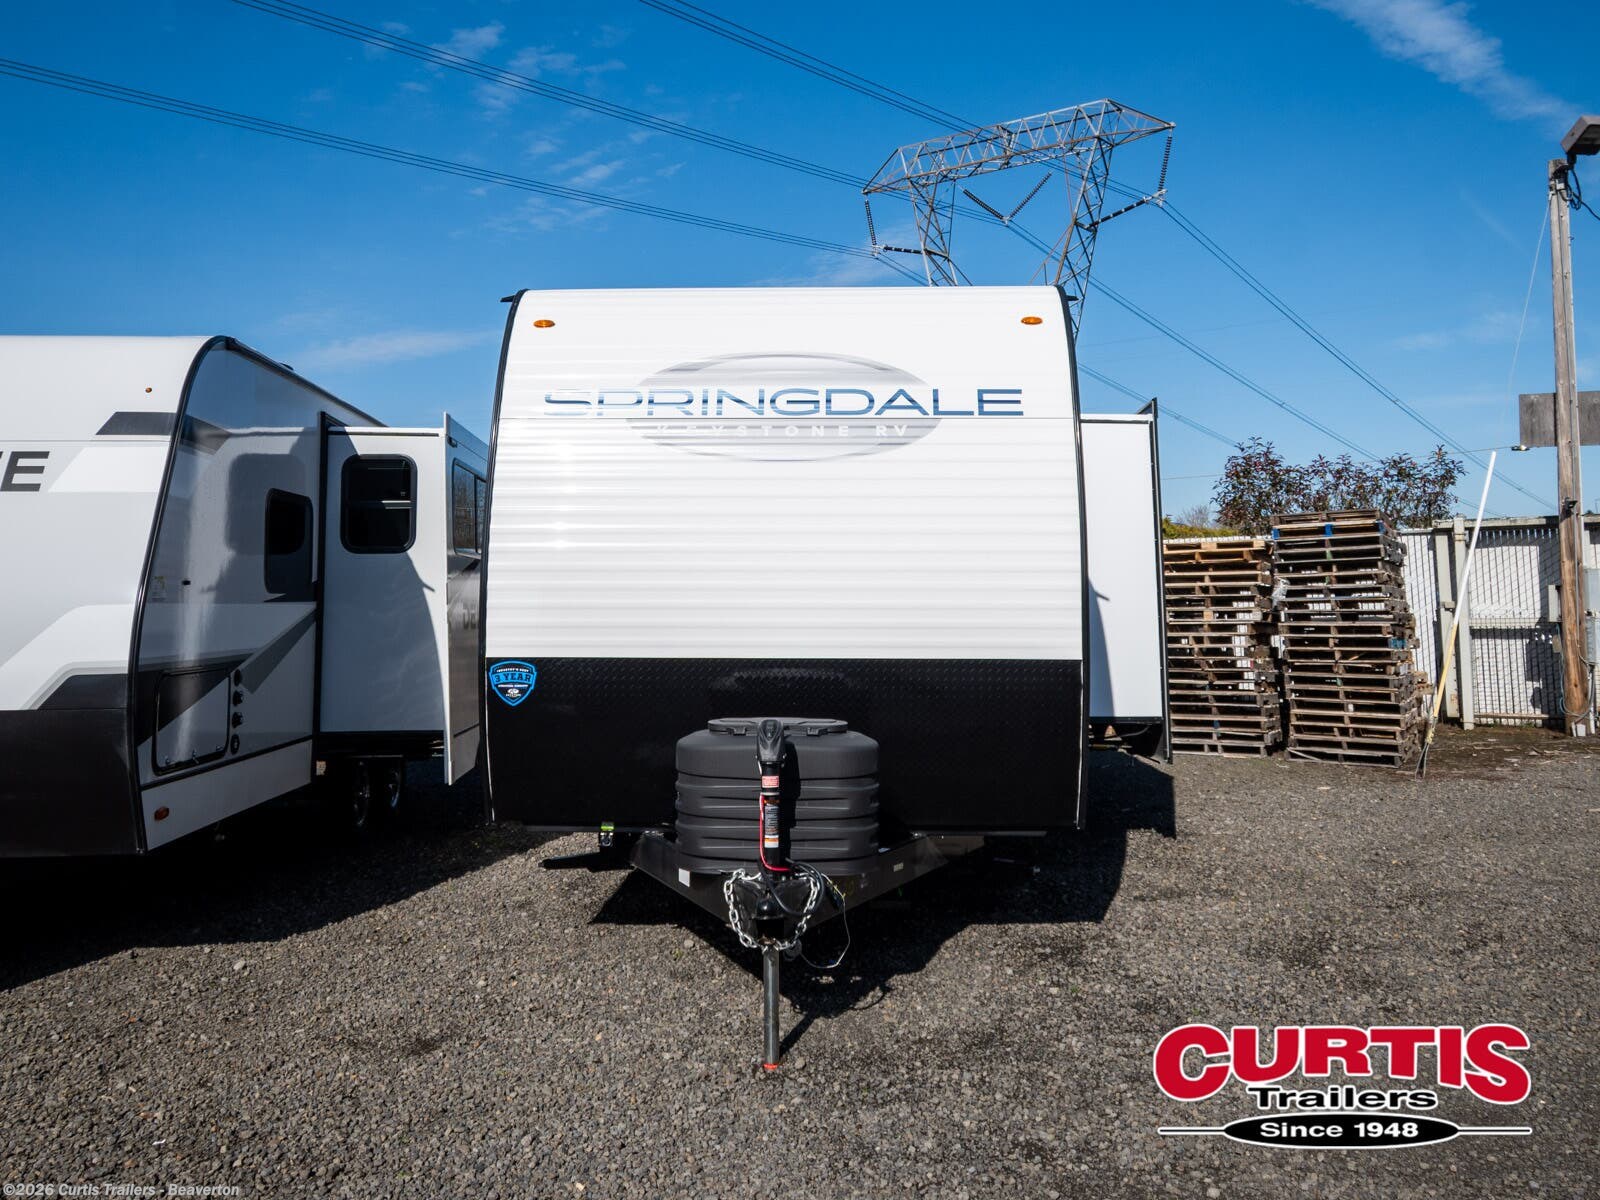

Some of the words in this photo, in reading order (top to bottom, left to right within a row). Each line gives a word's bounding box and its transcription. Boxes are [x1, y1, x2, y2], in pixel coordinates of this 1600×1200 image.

[543, 388, 1024, 416] SPRINGDALE
[656, 425, 849, 437] KEYSTONE
[875, 425, 908, 437] RV
[0, 451, 50, 492] E
[503, 672, 532, 682] YEAR
